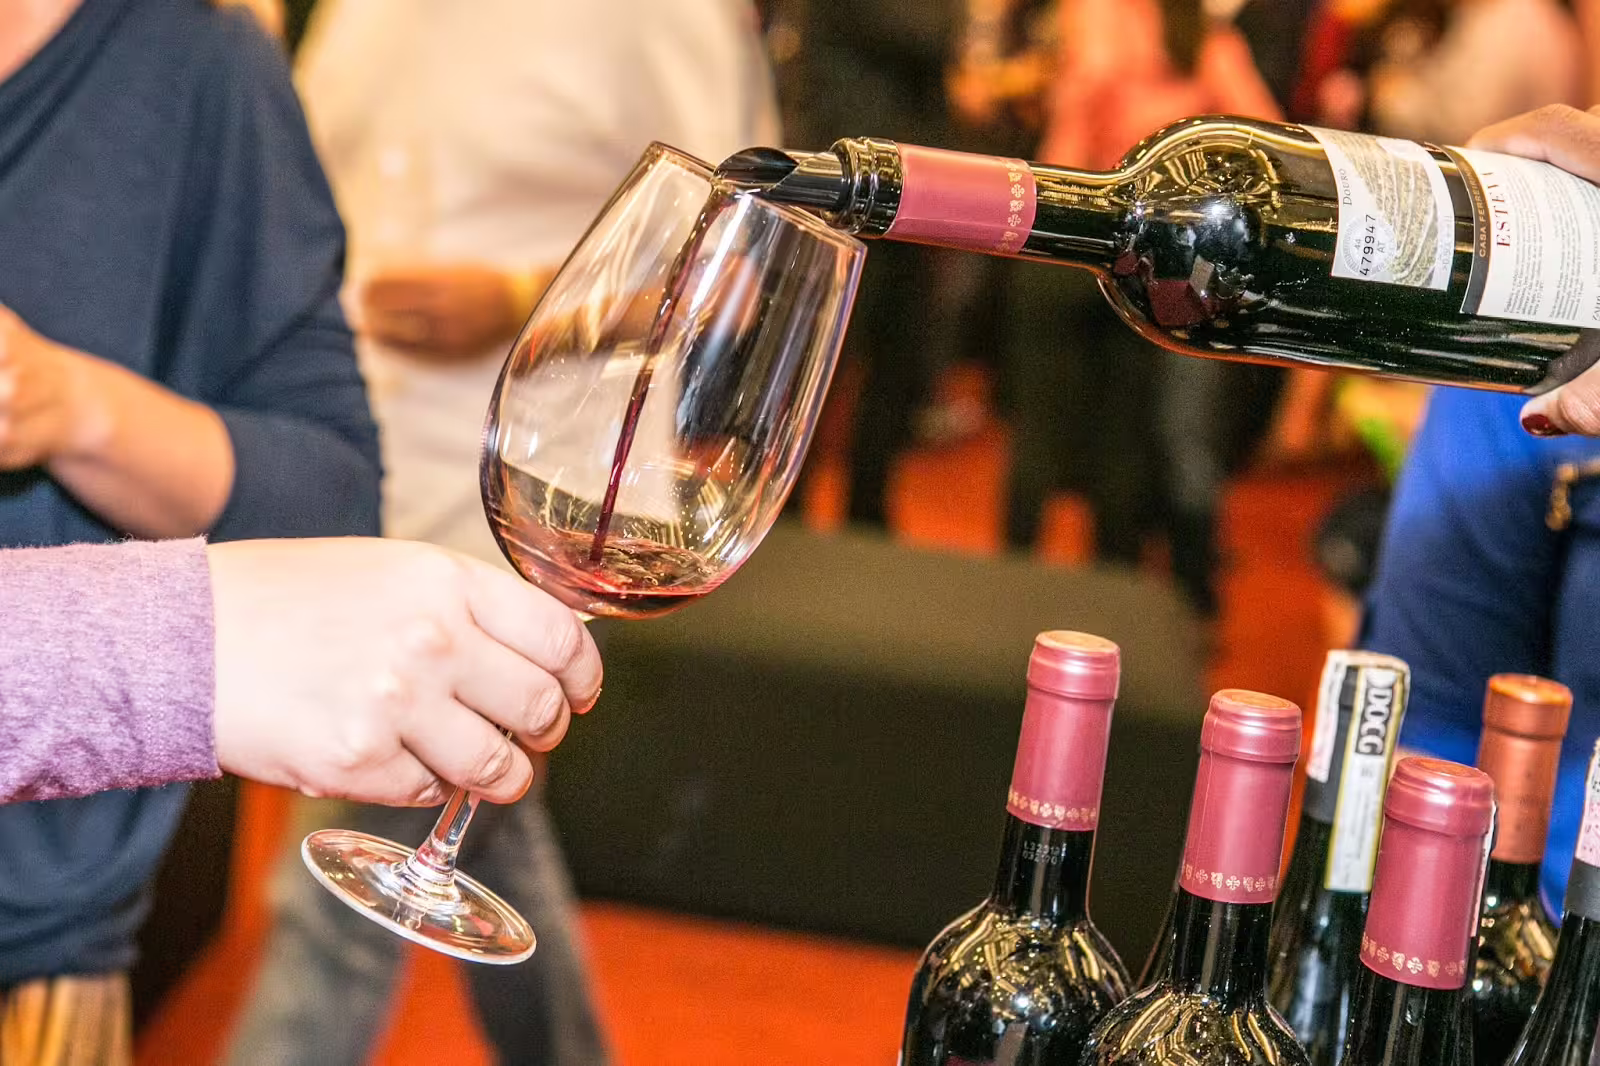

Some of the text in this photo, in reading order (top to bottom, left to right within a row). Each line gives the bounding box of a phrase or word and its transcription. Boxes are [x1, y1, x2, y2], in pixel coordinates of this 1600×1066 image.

[1354, 238, 1362, 251] 44
[1359, 214, 1376, 276] 479947
[1377, 241, 1386, 254] AT
[1478, 226, 1487, 258] CASA
[1357, 688, 1393, 753] DOCG
